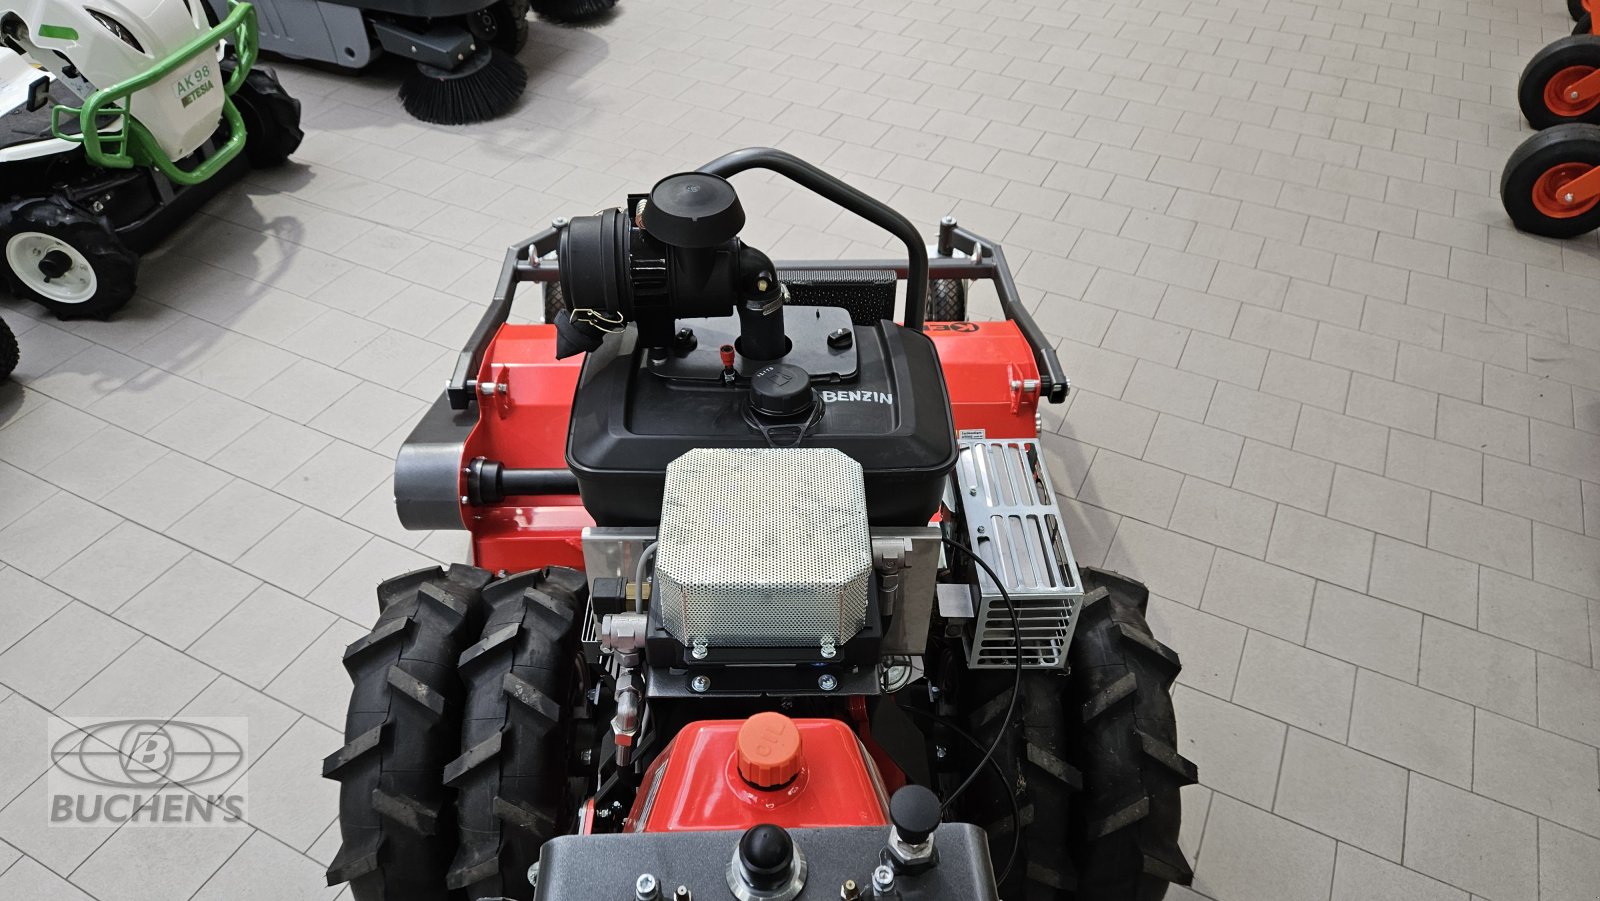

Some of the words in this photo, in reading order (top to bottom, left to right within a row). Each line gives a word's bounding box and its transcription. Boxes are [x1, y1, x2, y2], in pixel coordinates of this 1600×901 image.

[181, 80, 214, 108] ETESIA
[822, 389, 893, 405] BENZIN
[756, 721, 787, 757] OIL
